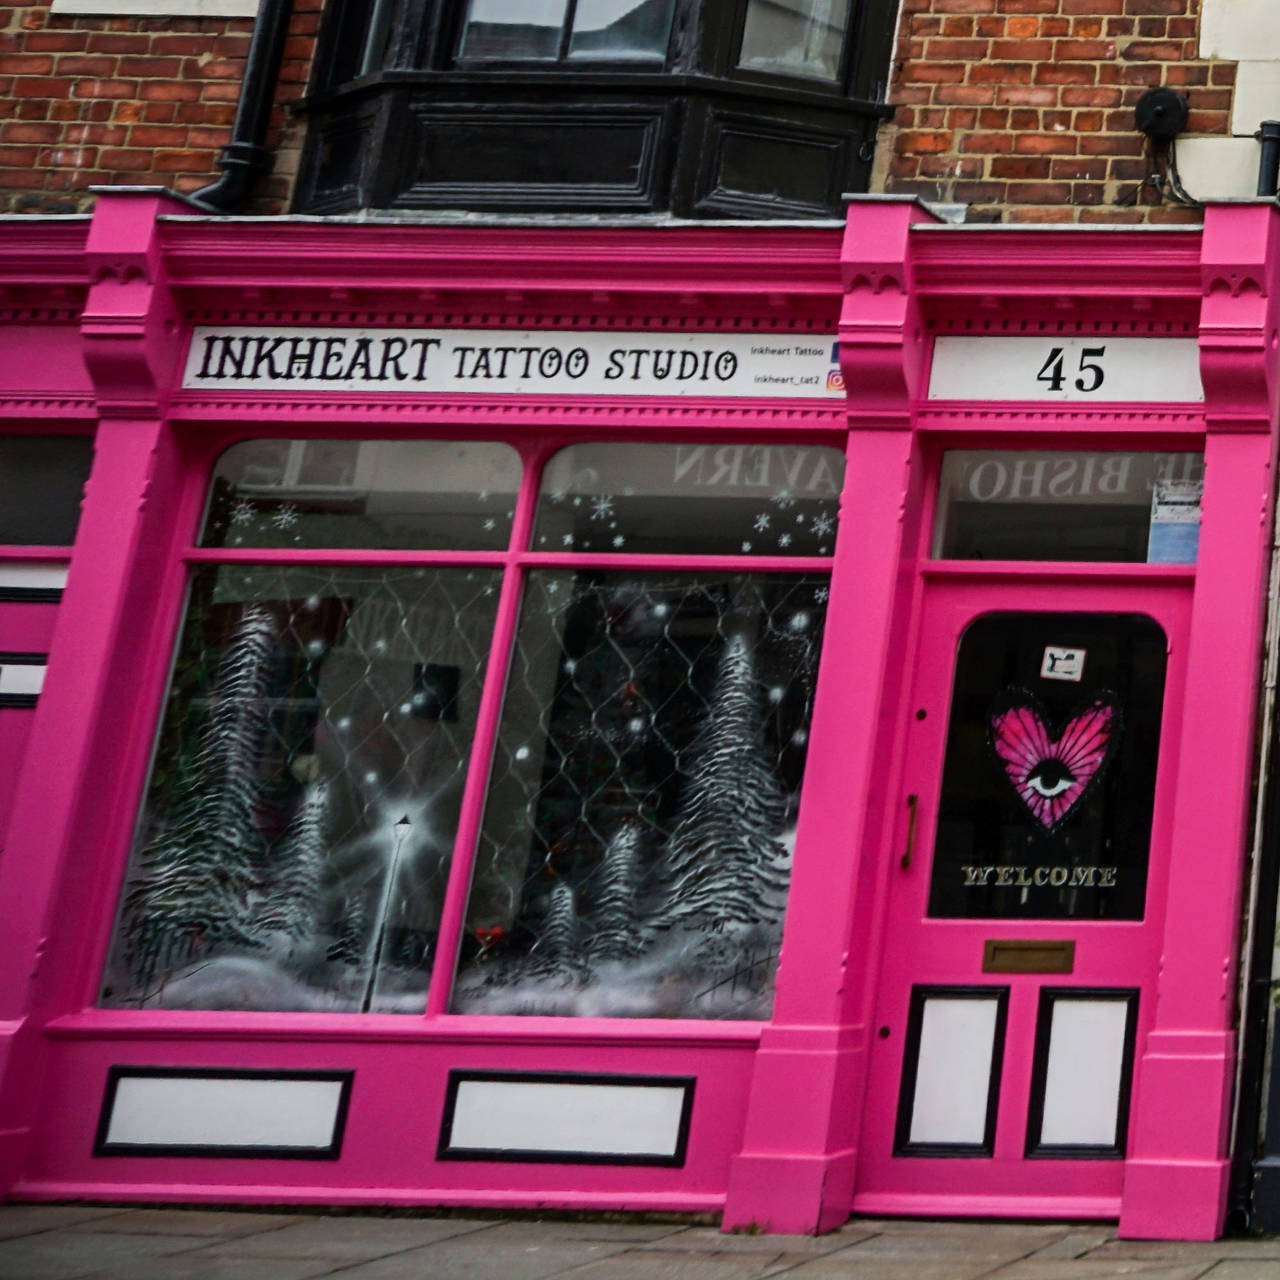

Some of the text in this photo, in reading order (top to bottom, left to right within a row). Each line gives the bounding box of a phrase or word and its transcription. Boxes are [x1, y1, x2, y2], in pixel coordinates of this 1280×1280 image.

[195, 335, 738, 382] INKHEART TATTOO STUDIO
[795, 346, 824, 356] Tattoo
[1036, 346, 1106, 393] 45
[960, 865, 1118, 887] WELCOME
